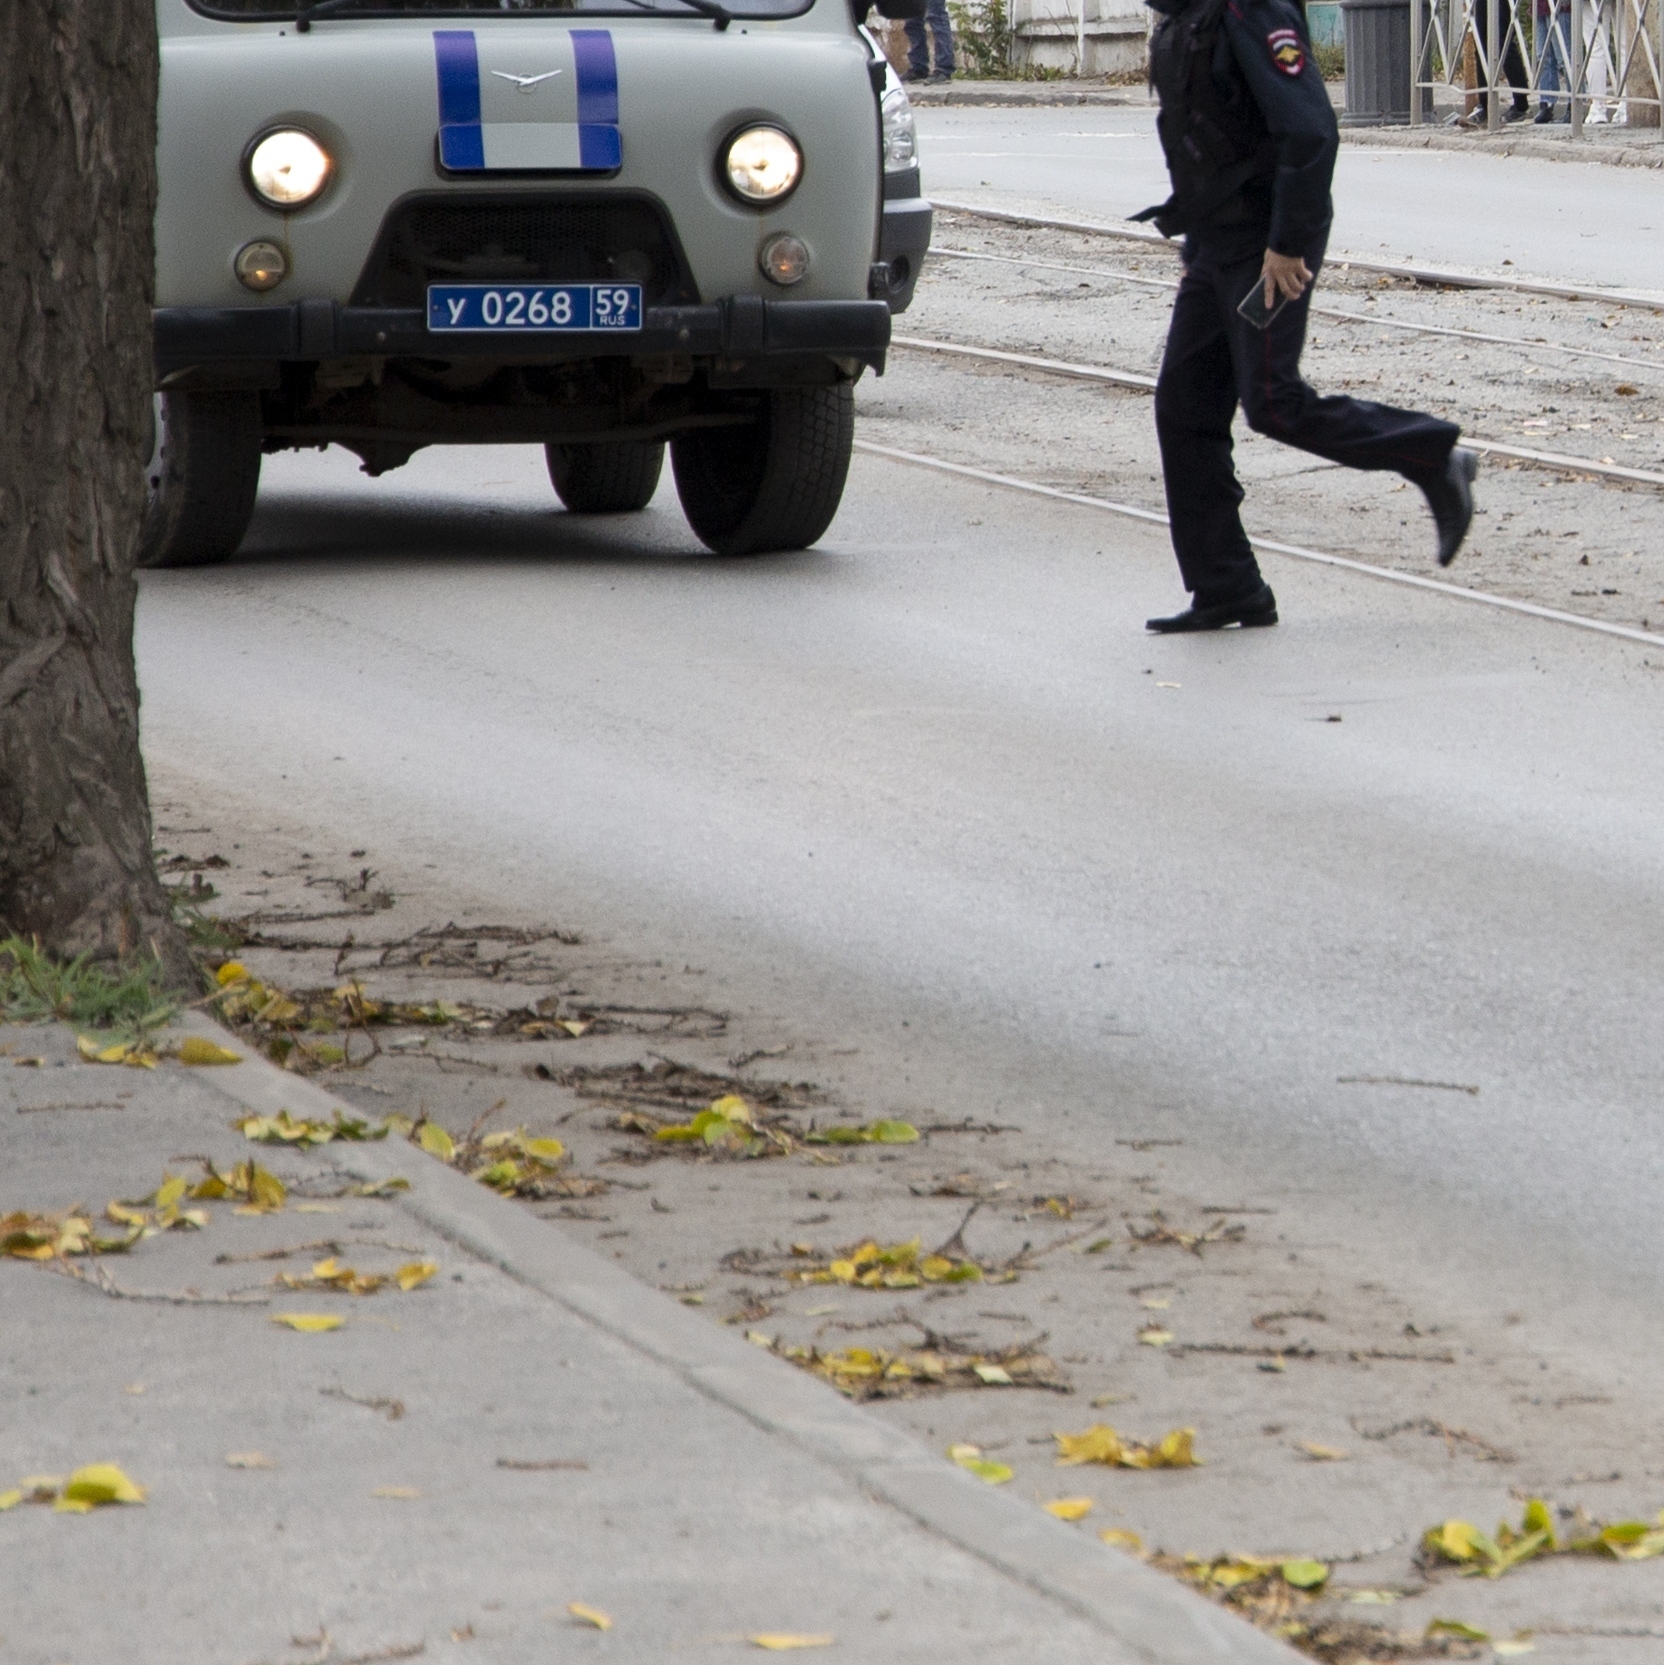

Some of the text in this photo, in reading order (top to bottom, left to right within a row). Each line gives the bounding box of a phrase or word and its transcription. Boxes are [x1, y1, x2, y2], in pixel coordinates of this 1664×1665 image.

[481, 291, 572, 325] 0268
[595, 289, 630, 316] 59
[600, 316, 626, 326] RUS
